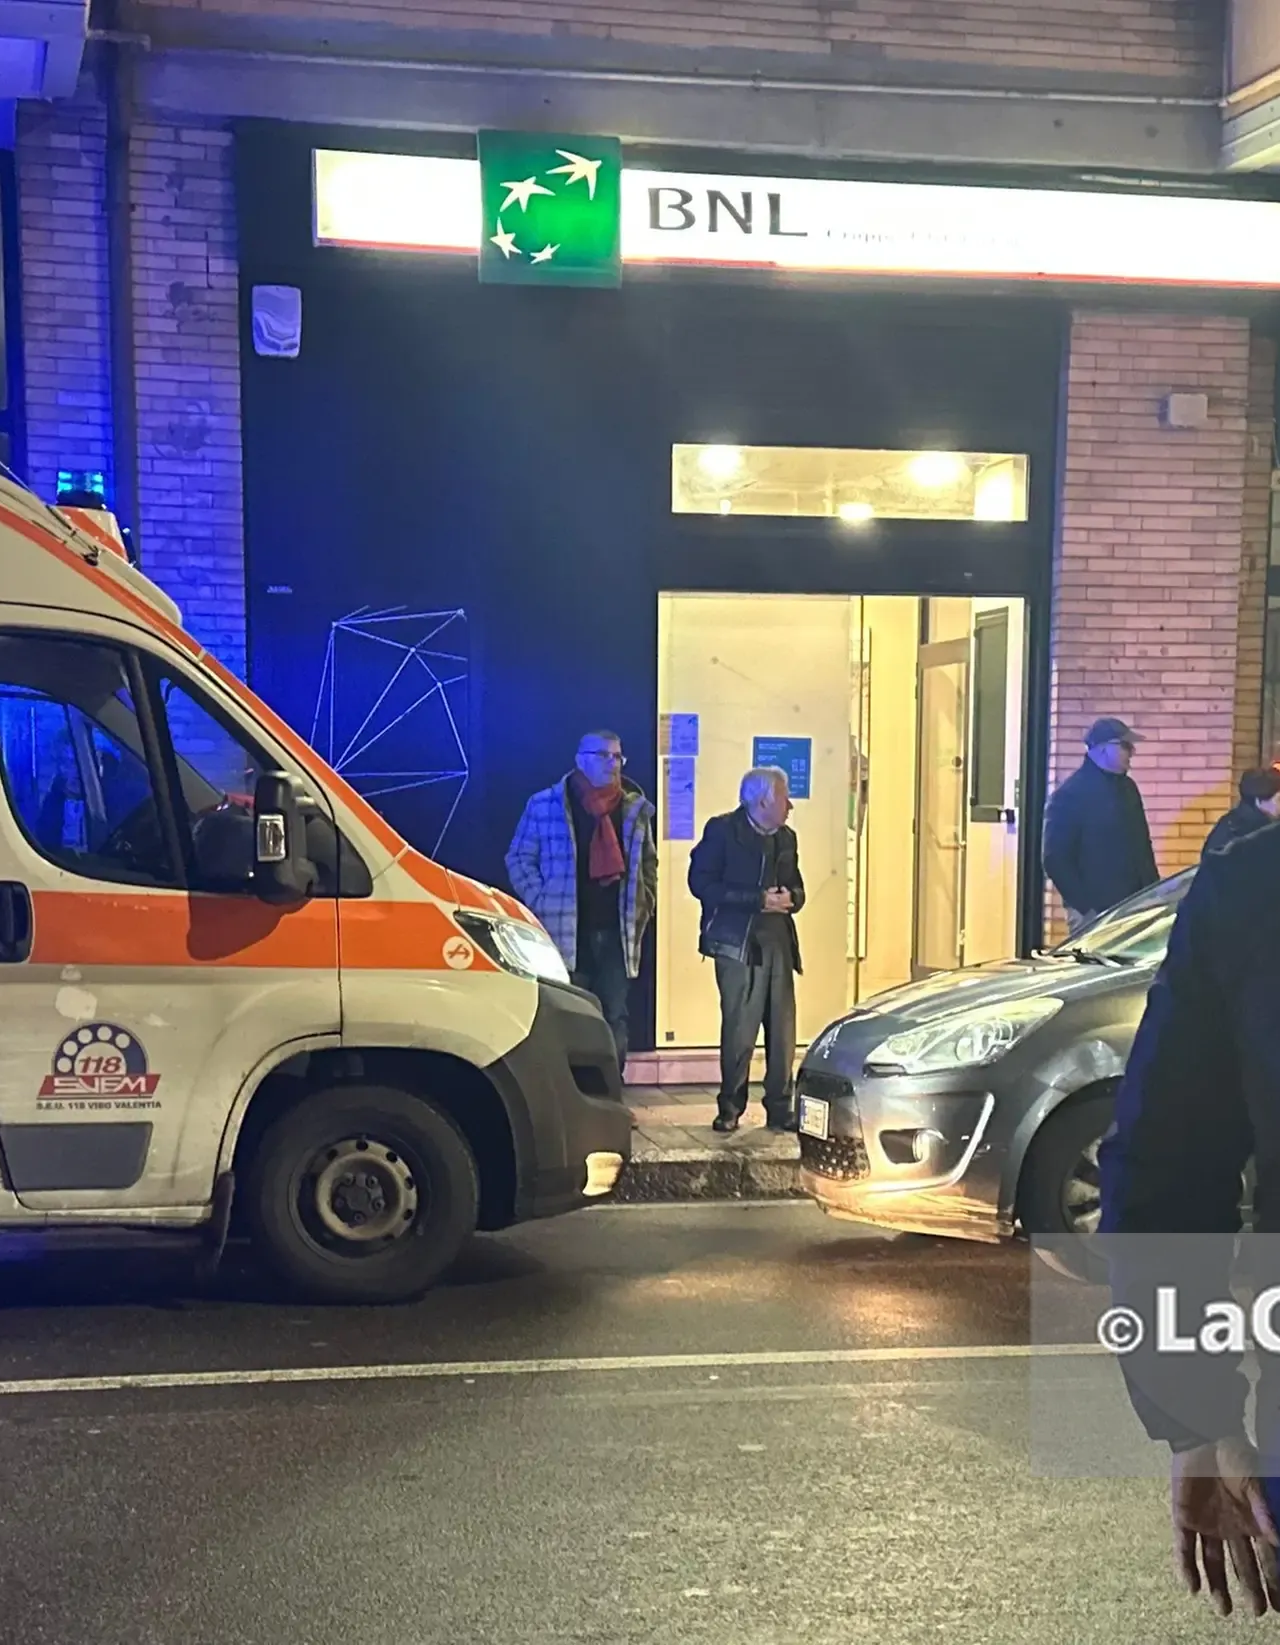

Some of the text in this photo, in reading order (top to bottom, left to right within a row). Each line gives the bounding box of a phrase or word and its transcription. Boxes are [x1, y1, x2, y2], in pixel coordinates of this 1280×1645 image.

[647, 187, 808, 237] BNL
[79, 1055, 122, 1074] 118
[114, 1100, 162, 1109] VALENTIA
